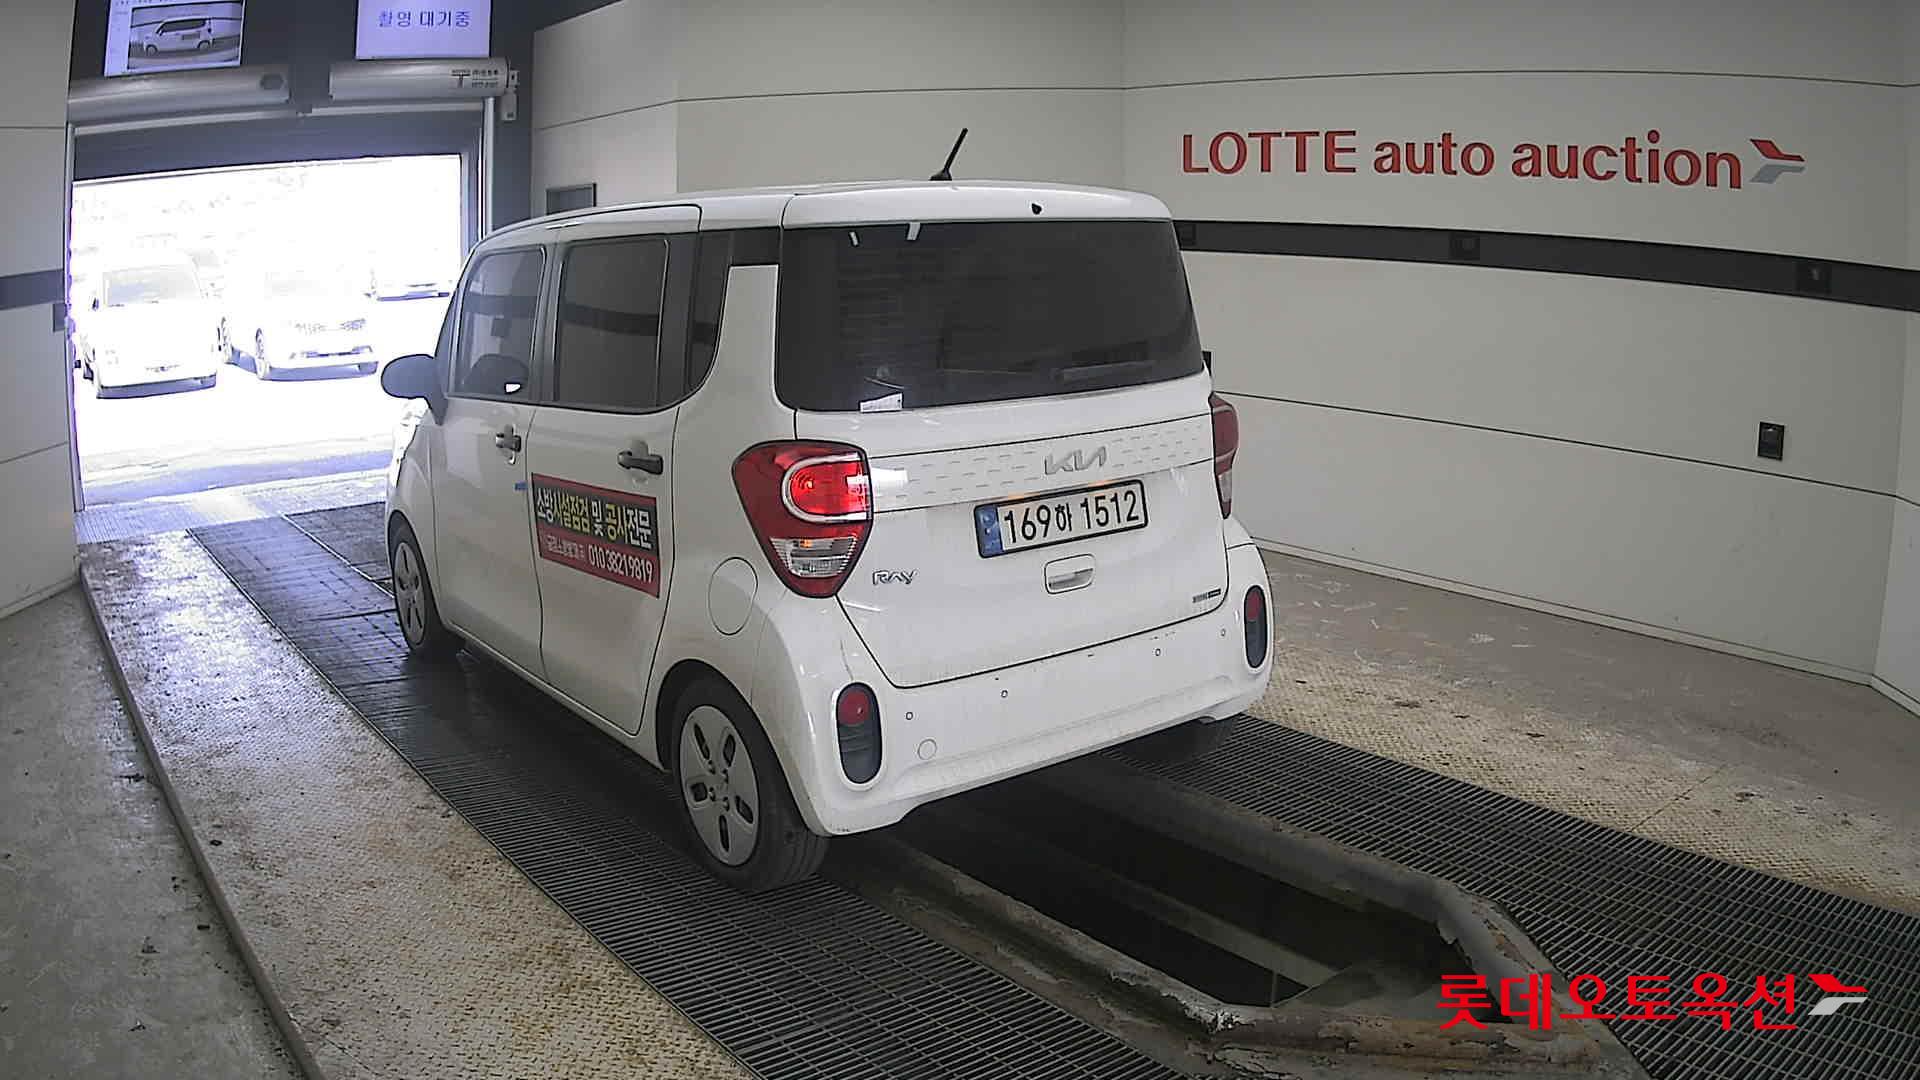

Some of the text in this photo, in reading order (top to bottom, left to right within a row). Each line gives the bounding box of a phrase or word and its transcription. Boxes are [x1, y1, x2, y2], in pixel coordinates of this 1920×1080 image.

[419, 10, 470, 28] 대기중
[1182, 130, 1742, 189] LOTTE auto auction
[591, 500, 604, 537] 및
[1004, 489, 1140, 544] 169하 1512
[872, 569, 918, 585] RAY
